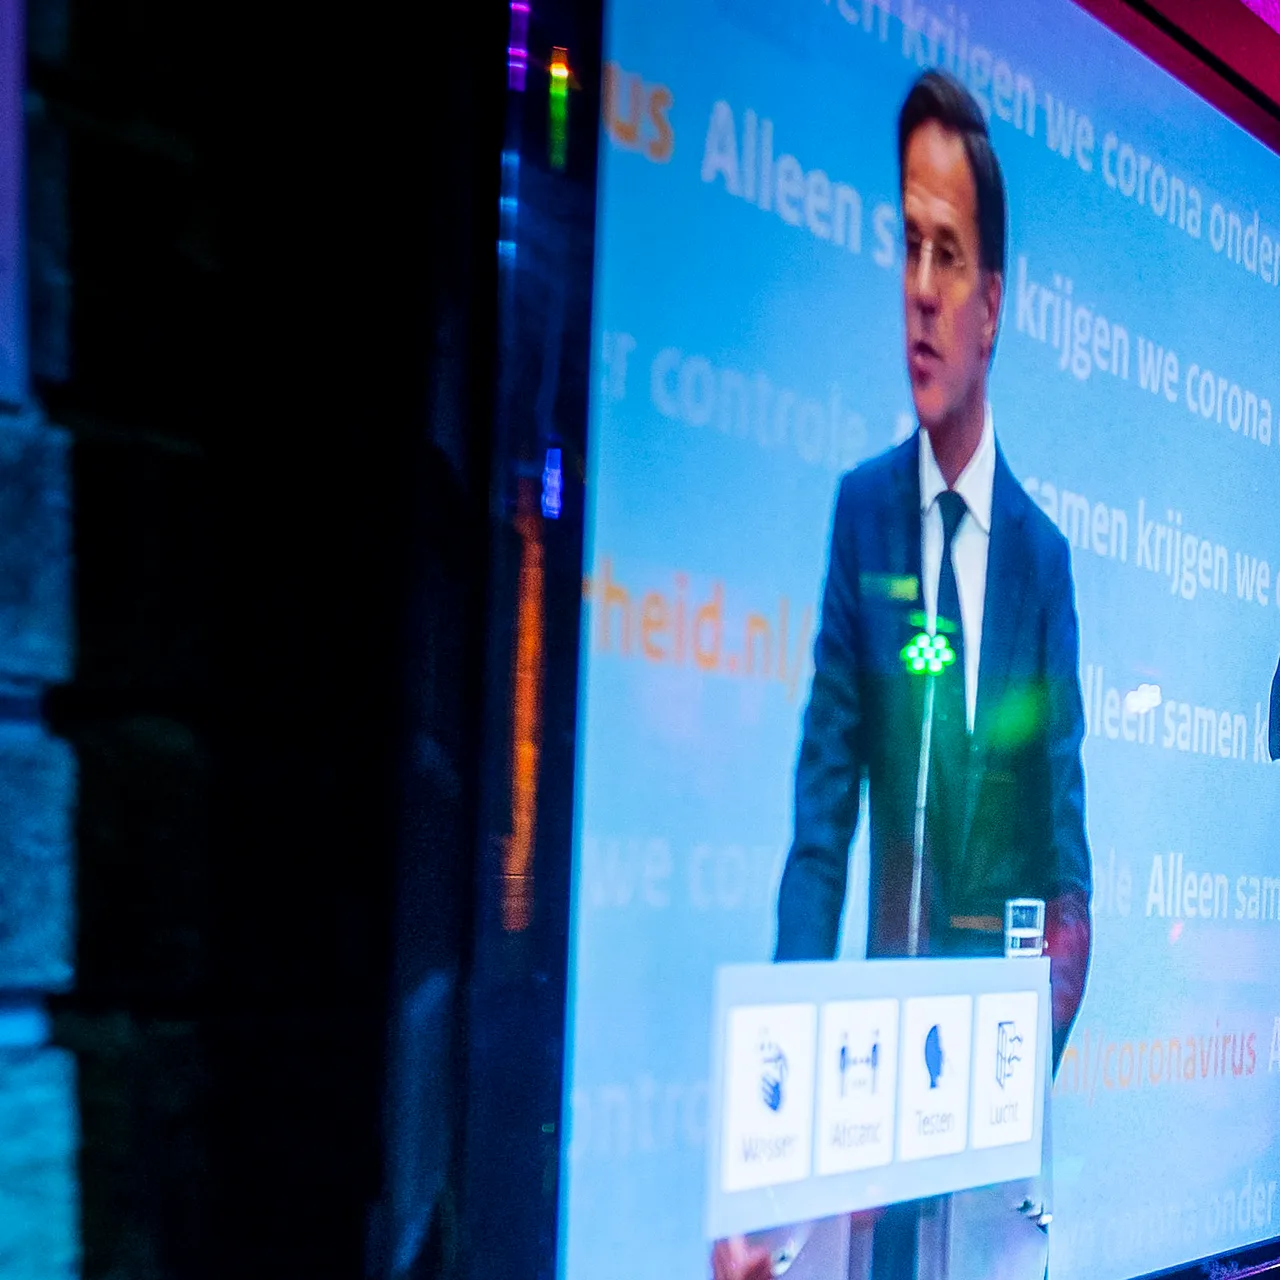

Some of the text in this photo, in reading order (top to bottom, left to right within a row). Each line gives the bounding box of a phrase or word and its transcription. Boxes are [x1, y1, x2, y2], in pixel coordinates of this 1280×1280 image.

[700, 100, 862, 254] Alleen
[1045, 92, 1095, 172] we
[1102, 131, 1200, 239] corona
[1016, 256, 1130, 381] krijgen
[1136, 336, 1179, 403] we
[1186, 363, 1272, 448] corona
[1023, 476, 1128, 562] amen
[1136, 497, 1229, 600] krijgen
[1235, 551, 1270, 606] we
[1084, 664, 1155, 745] lleen
[1163, 701, 1247, 761] samen
[1145, 853, 1229, 920] Alleen
